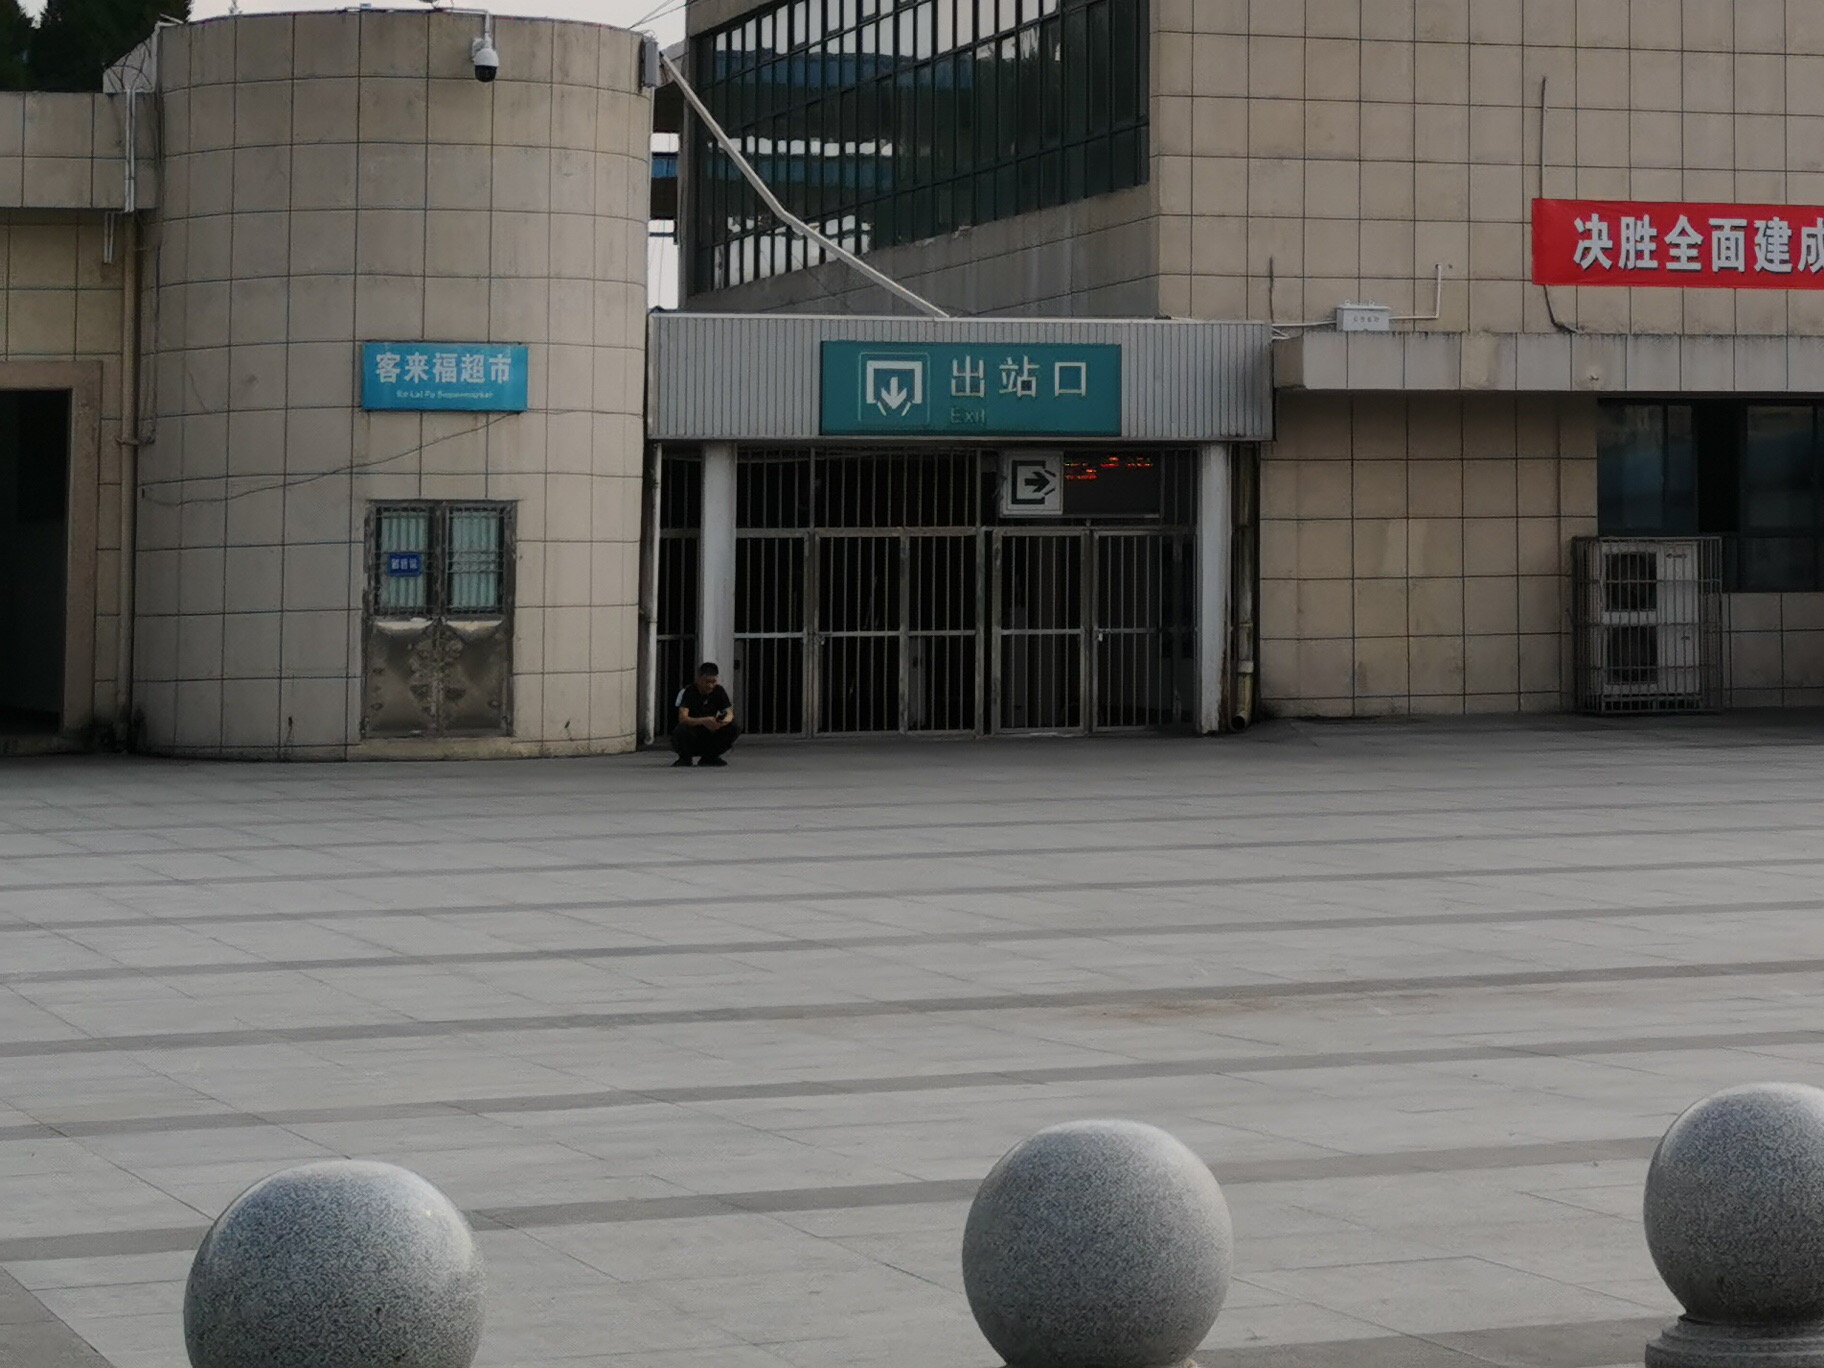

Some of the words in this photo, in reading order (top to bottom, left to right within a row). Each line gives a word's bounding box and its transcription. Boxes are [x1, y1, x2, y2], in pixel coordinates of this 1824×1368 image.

[375, 351, 512, 384] 客来福超市
[950, 354, 1087, 398] 出站口
[950, 407, 986, 424] Exit
